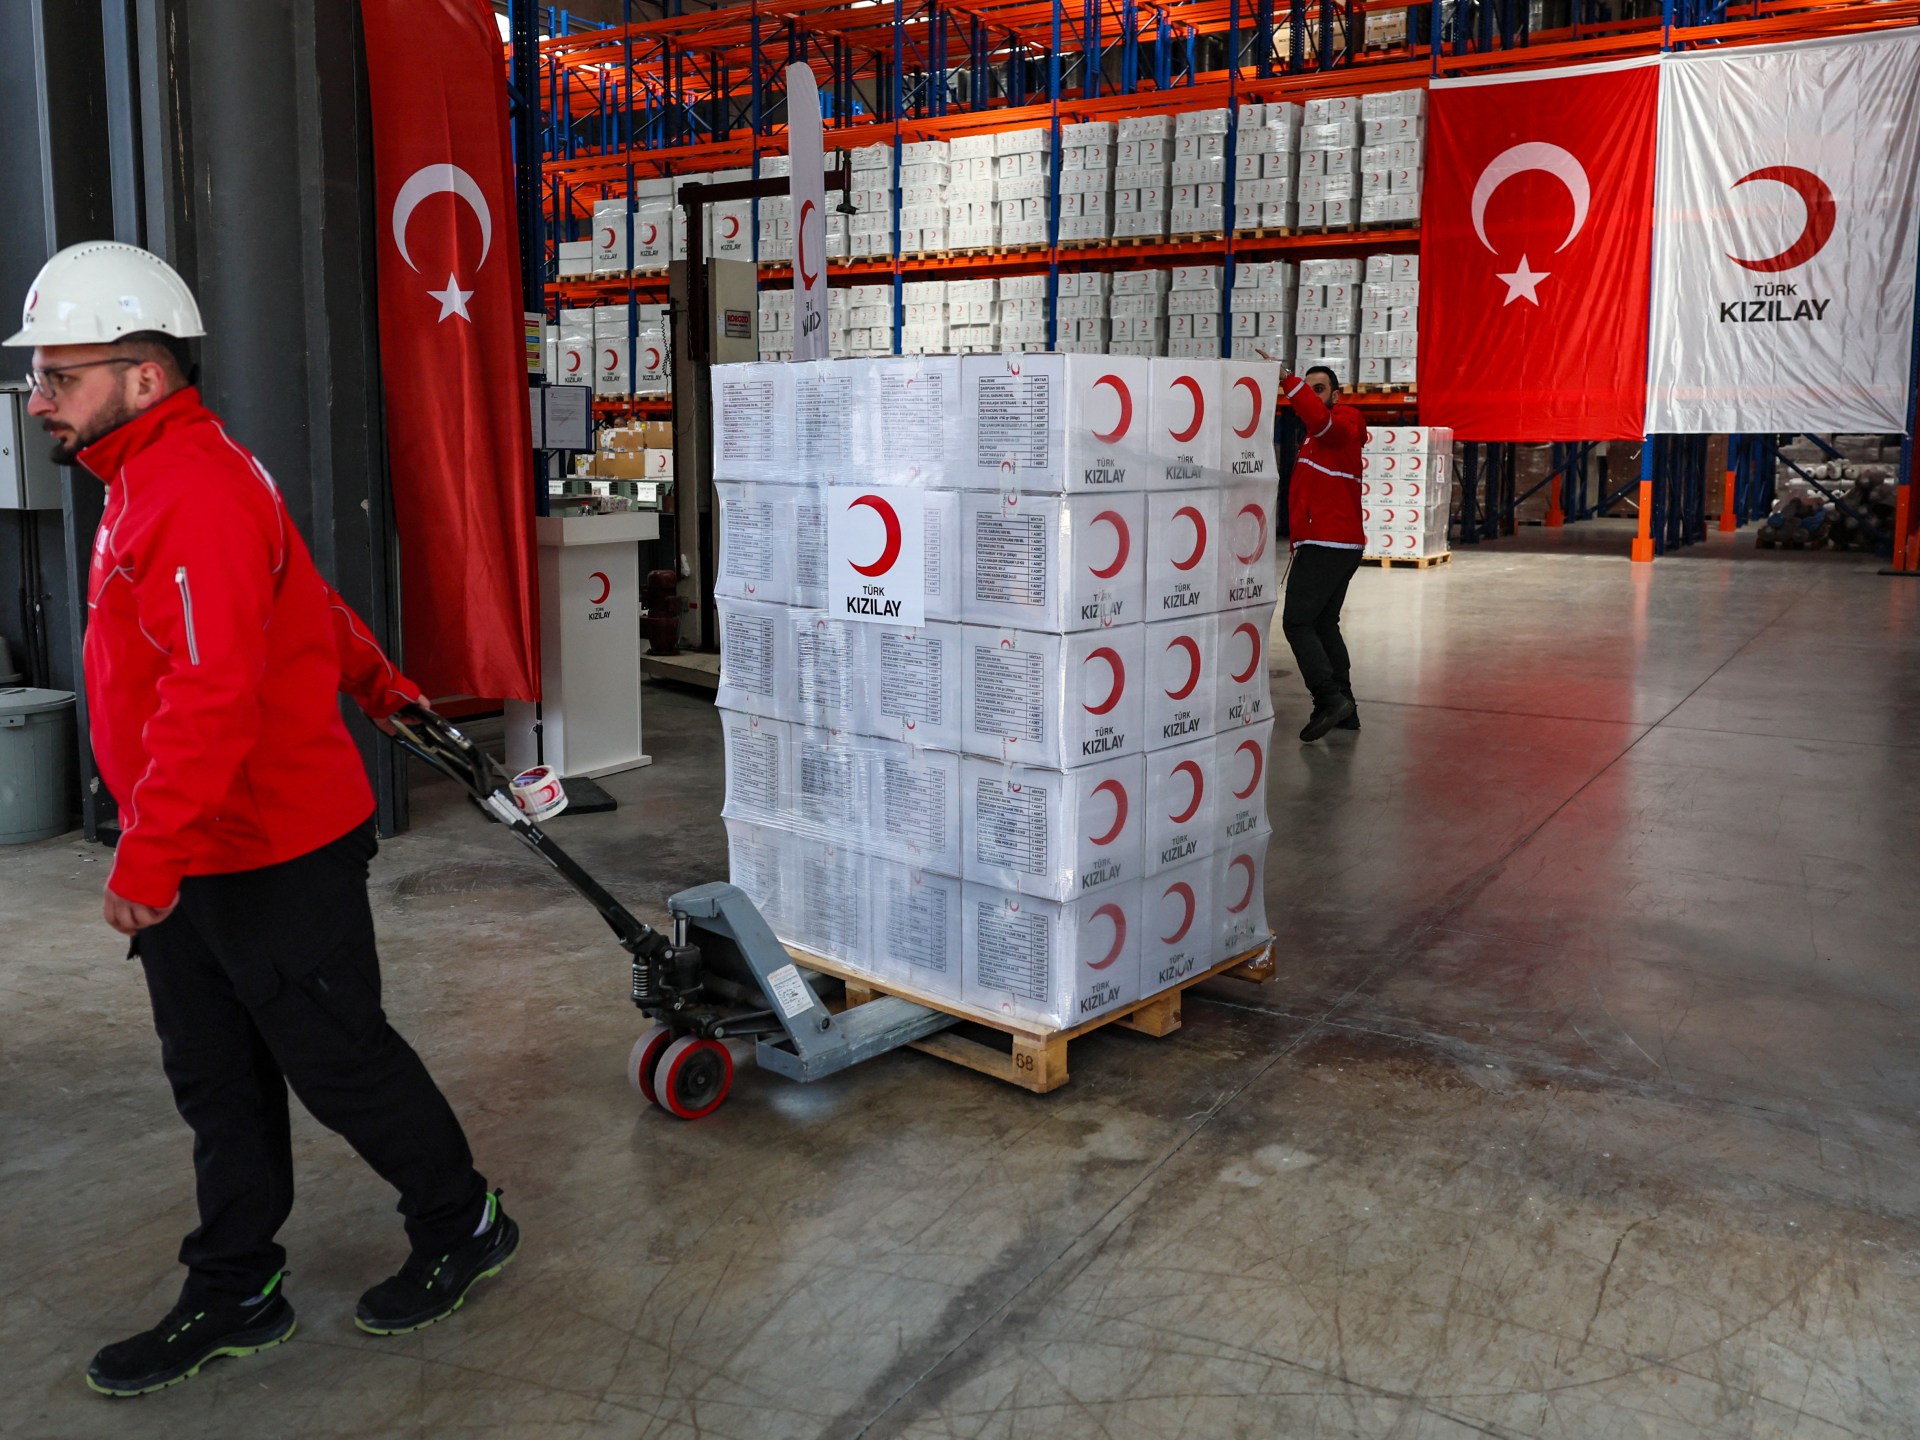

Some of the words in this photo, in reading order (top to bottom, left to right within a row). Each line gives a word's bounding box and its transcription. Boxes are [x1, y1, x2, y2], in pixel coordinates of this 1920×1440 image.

[1754, 282, 1797, 296] TÜRK
[1720, 299, 1830, 322] KIZILAY
[1097, 458, 1115, 467] TÜRK
[1178, 455, 1194, 464] TÜRK
[1241, 451, 1255, 460] TÜRK
[1166, 466, 1203, 480] KIZILAY
[1232, 460, 1263, 475] KIZILAY
[1085, 469, 1126, 484] KIZILAY
[1175, 583, 1190, 592] TÜRK
[1240, 577, 1254, 585] TRK
[863, 584, 885, 596] TÜRK
[1094, 590, 1112, 602] TRK
[1230, 584, 1262, 602] KIZILAY
[847, 596, 901, 617] KIZILAY
[1163, 592, 1200, 609] KIZILAY
[589, 611, 610, 620] KIZILAY
[1175, 711, 1190, 721] TÜRK
[1230, 700, 1260, 720] KIZAY
[1095, 726, 1114, 737] TÜRK
[1163, 718, 1200, 738] KIZILAY
[1083, 734, 1125, 756] KIZILAY
[1236, 810, 1249, 820] TÜRK
[1226, 816, 1257, 837] KIZILAY
[1172, 834, 1188, 845] TÜRK
[1162, 840, 1197, 864] KIZILAY
[1093, 858, 1111, 869] TÜRK
[1082, 864, 1121, 889] KIZILAY
[1160, 958, 1194, 984] KIZIAY
[1092, 981, 1110, 994] TÜRK
[1081, 987, 1120, 1013] KIZILAY
[1016, 1053, 1034, 1071] 68
